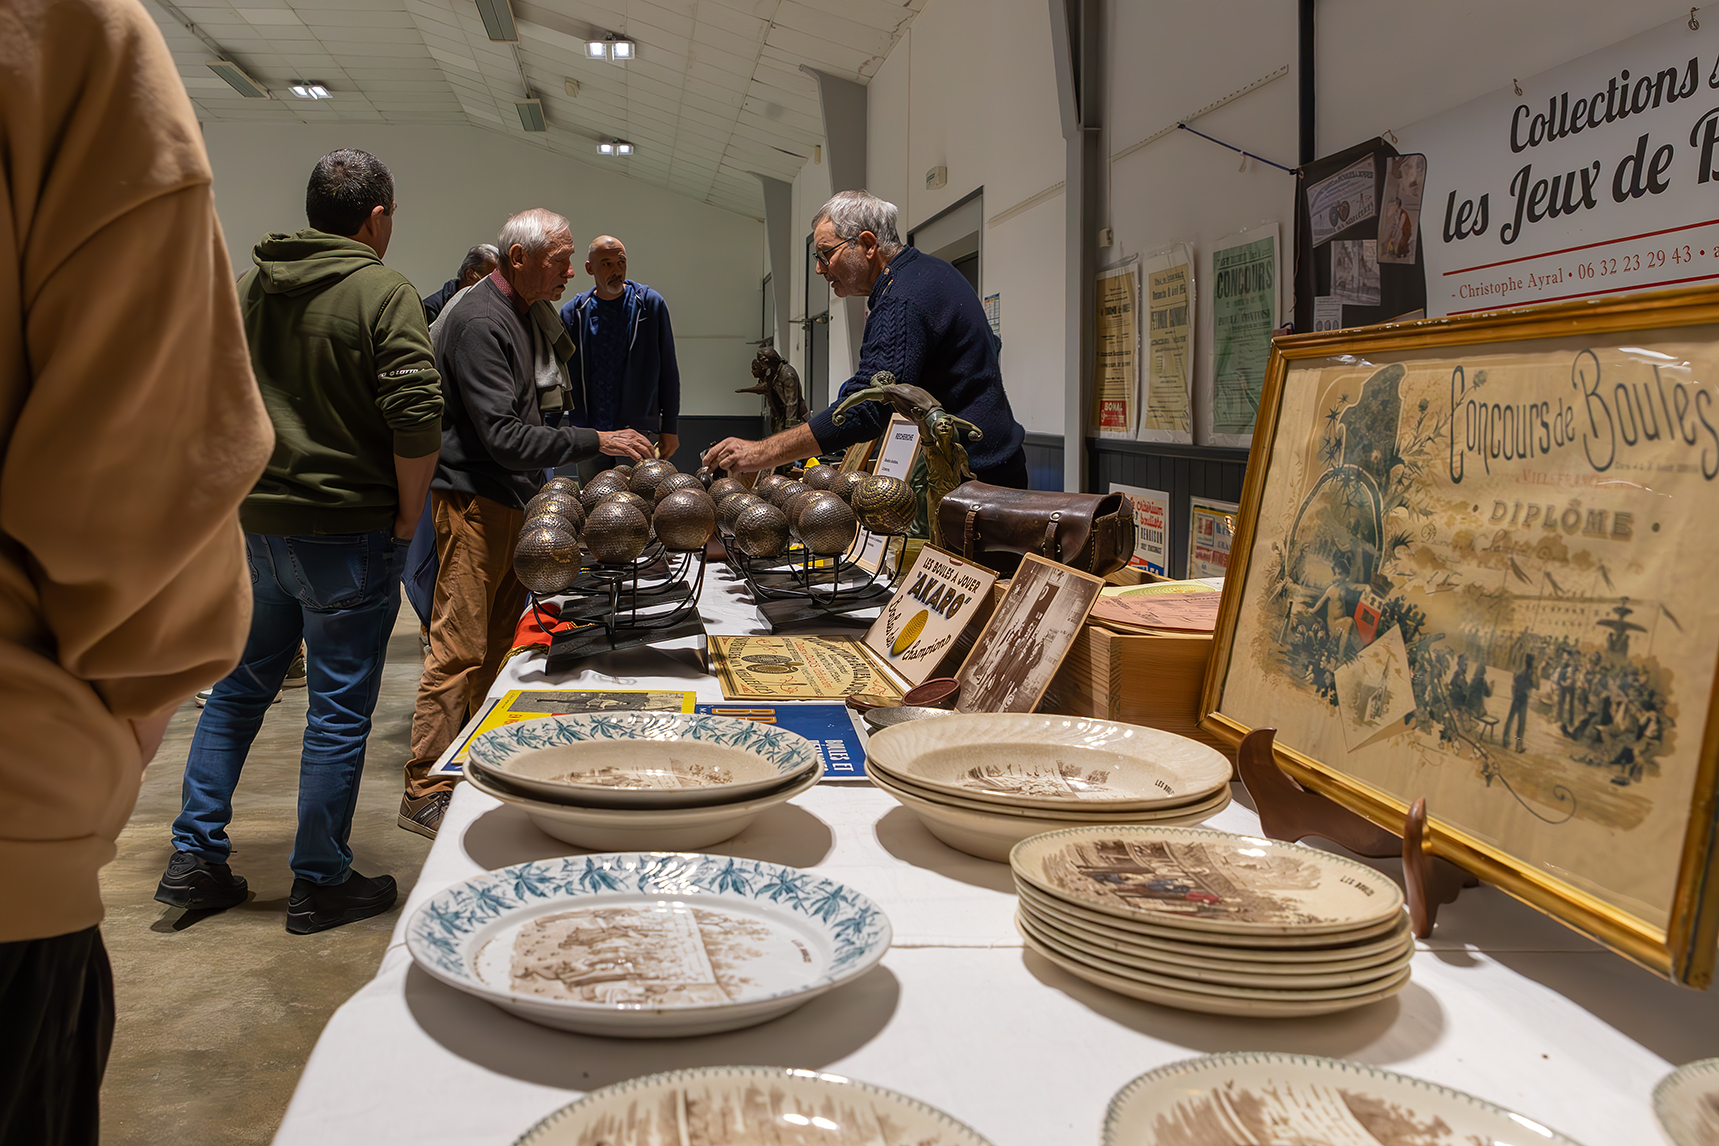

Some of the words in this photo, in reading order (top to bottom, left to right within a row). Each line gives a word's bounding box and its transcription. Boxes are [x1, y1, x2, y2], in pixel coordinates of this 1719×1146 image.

[1510, 56, 1699, 154] Collections
[1443, 189, 1489, 243] les
[1500, 160, 1602, 245] Jeux
[1612, 132, 1674, 203] de
[1216, 260, 1273, 299] CONCOURS
[1459, 277, 1523, 299] Christophe
[1527, 268, 1563, 291] Ayral
[1578, 262, 1595, 280] 06
[1600, 258, 1618, 276] 32
[1623, 253, 1641, 272] 23
[1647, 249, 1666, 269] 29
[1672, 244, 1692, 264] 43
[1450, 365, 1550, 484] Concours
[1553, 397, 1575, 448] de
[1571, 349, 1719, 481] Boules
[1489, 499, 1634, 541] DIPLÔME
[922, 556, 934, 571] LES
[931, 561, 954, 580] BOULES
[957, 573, 981, 594] JOUER
